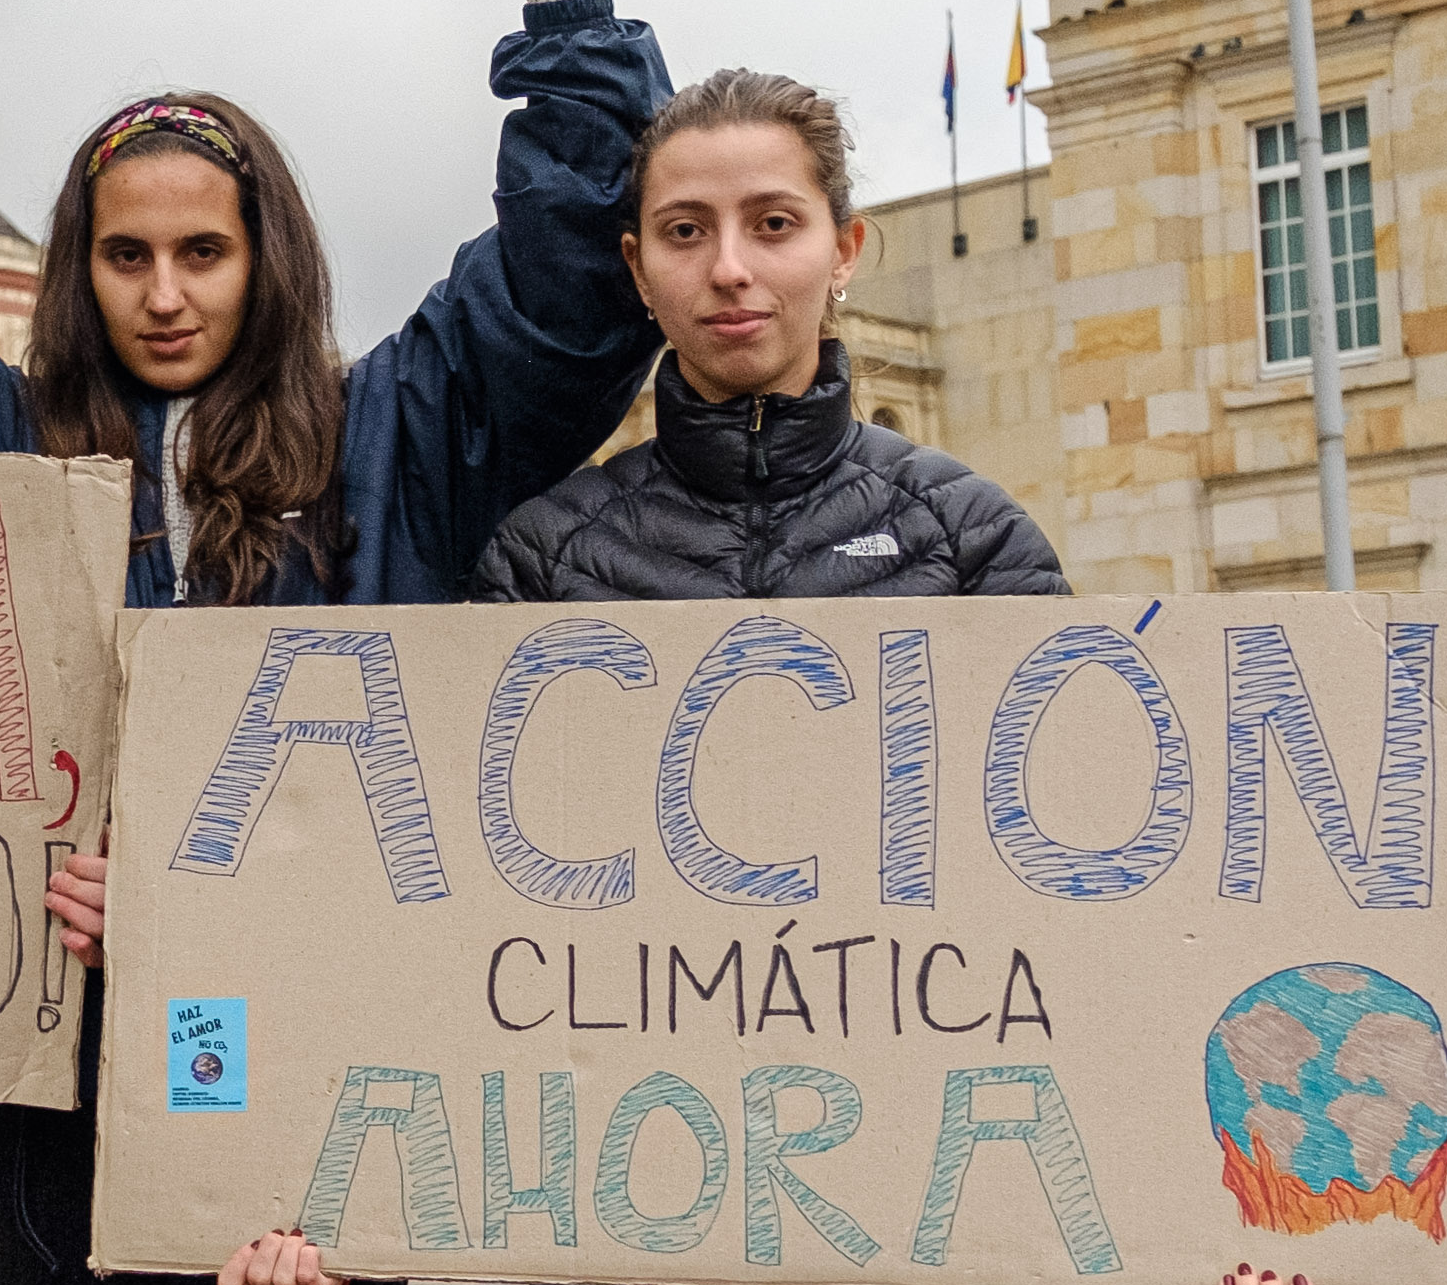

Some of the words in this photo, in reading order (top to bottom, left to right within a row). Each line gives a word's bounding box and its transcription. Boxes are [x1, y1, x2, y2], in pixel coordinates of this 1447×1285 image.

[168, 599, 1439, 911] ACCIÓN
[177, 1005, 203, 1023] HAZ
[487, 920, 1052, 1044] CLIMÁTICA
[171, 1031, 185, 1044] EL
[188, 1018, 223, 1039] AMOR
[198, 1040, 211, 1049] NO
[296, 1064, 1124, 1275] AHORA
